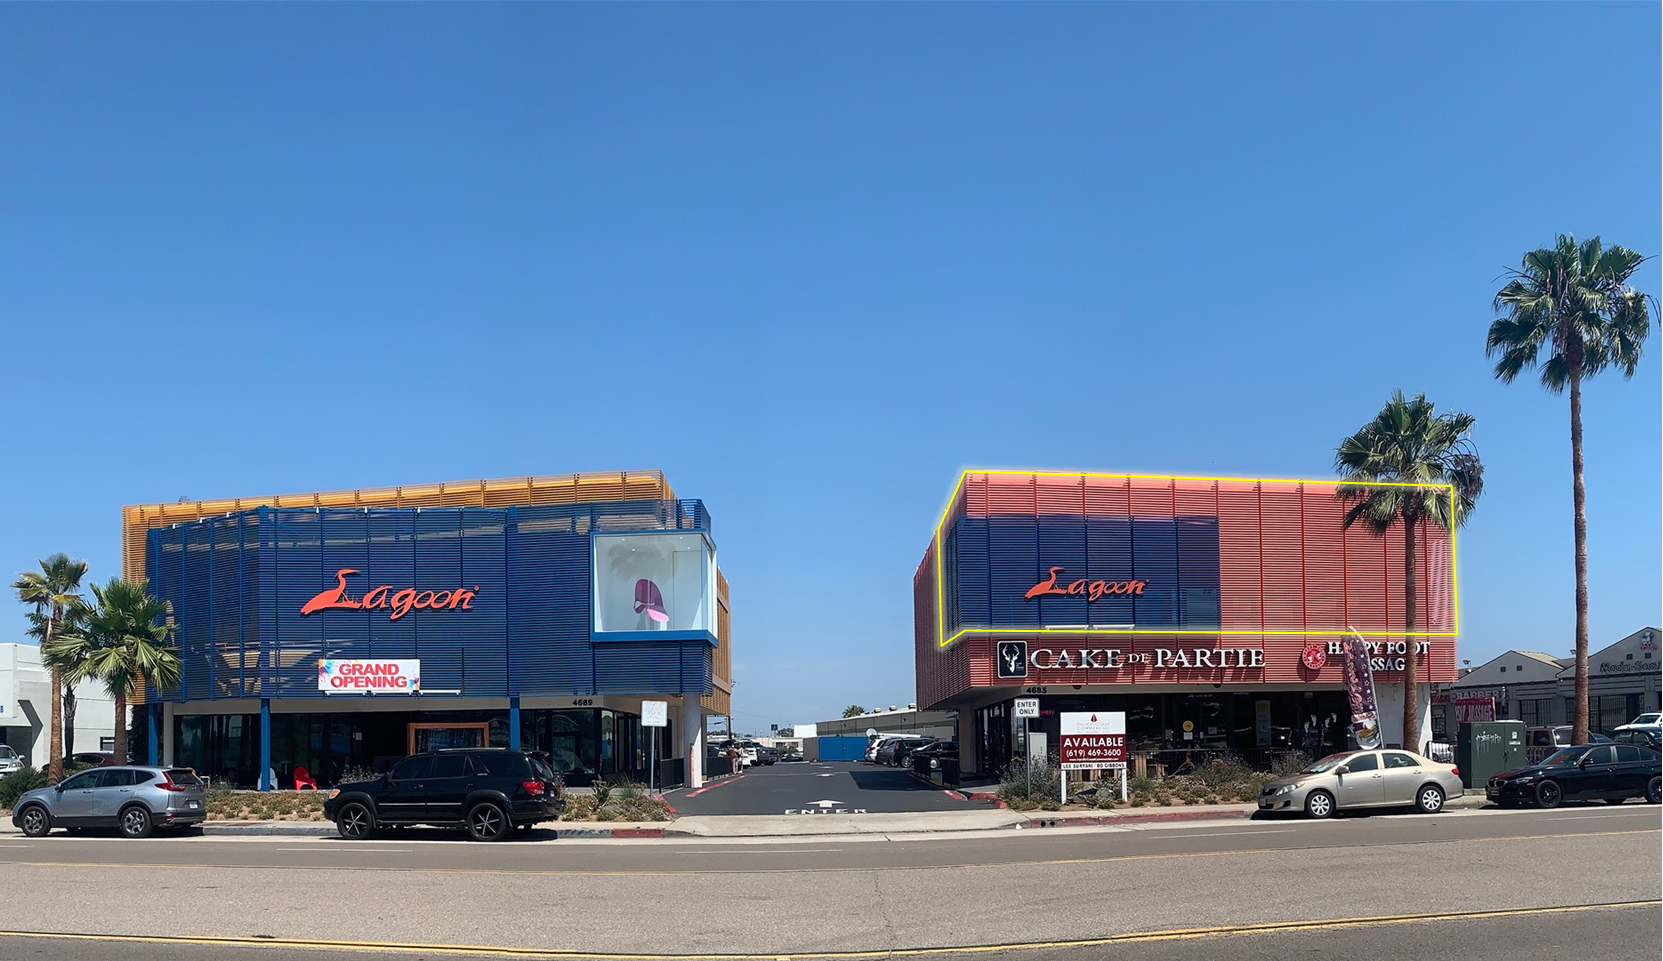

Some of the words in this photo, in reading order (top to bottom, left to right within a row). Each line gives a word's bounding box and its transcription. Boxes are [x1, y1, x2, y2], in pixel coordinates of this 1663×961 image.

[1025, 566, 1147, 602] Lagoon
[301, 569, 476, 620] Lagoon
[1327, 641, 1380, 654] HPY
[1030, 648, 1123, 669] CAKE
[1127, 653, 1149, 663] DE
[1154, 648, 1266, 668] PARTIE
[338, 663, 399, 675] GRAND
[330, 675, 408, 688] OPENING
[1063, 737, 1124, 748] AVAILABLE
[1066, 749, 1085, 757] (619)
